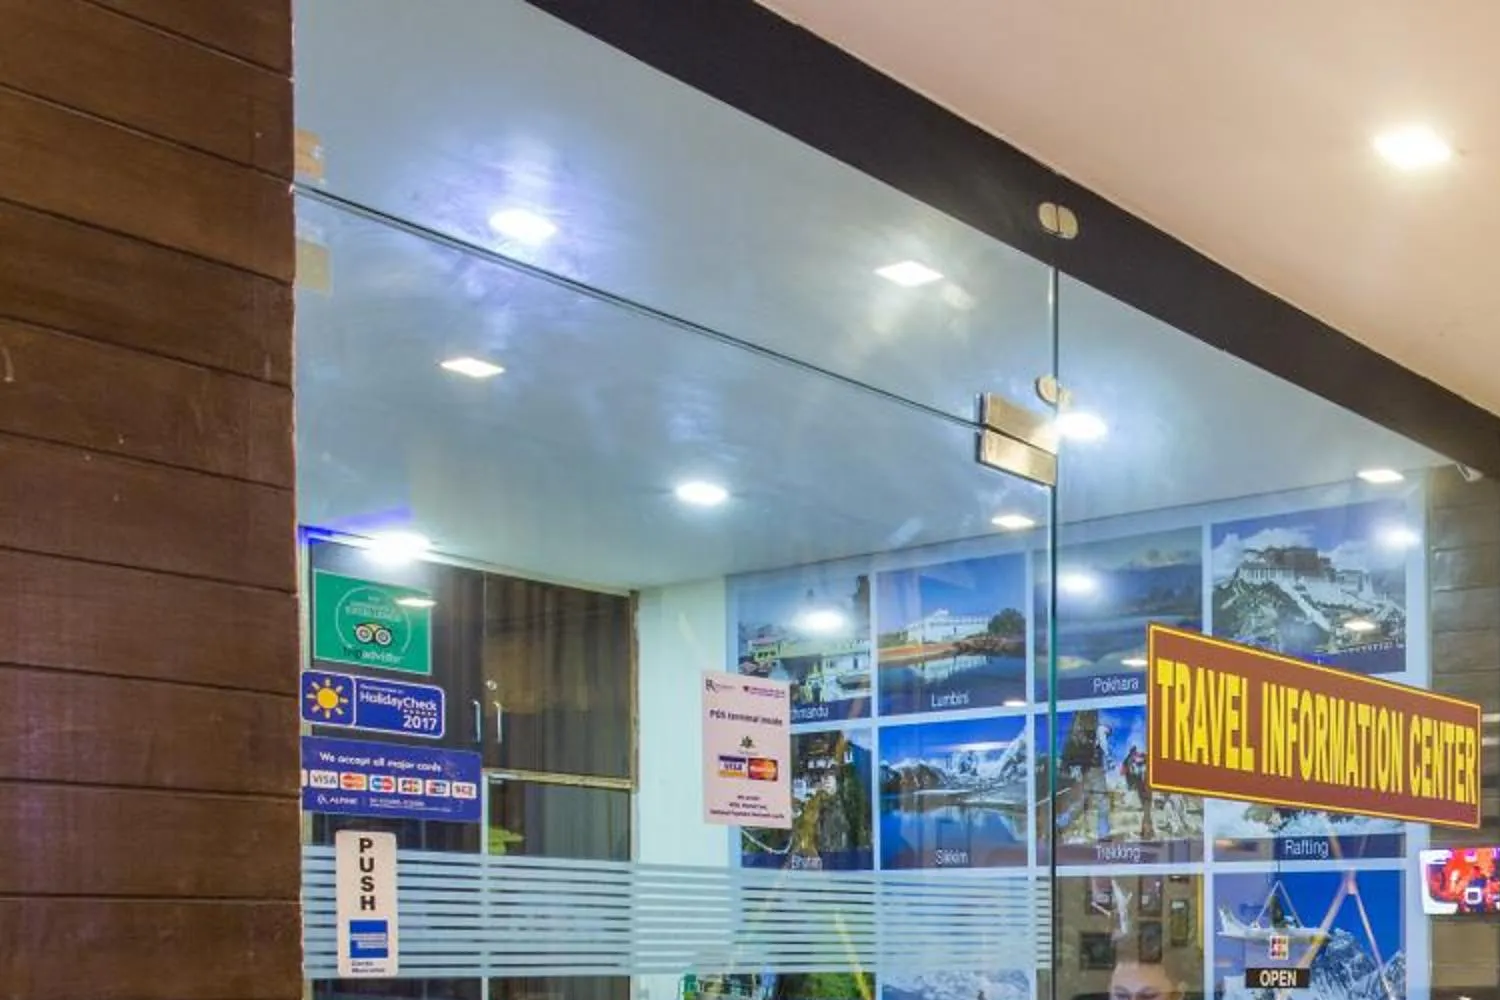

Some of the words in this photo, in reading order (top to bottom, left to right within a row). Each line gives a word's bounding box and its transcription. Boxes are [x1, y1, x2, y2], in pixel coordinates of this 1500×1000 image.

[1093, 676, 1139, 694] Pokhara
[360, 690, 436, 711] HolidayCheck
[403, 714, 437, 731] 2017
[1156, 657, 1255, 773] TRAVEL
[1262, 681, 1404, 794] INFORMATION
[1409, 713, 1478, 805] CENTER
[319, 751, 335, 763] We
[337, 755, 370, 767] accept
[313, 774, 337, 785] VISA
[1285, 839, 1329, 859] Rafting
[359, 837, 376, 911] PUSH
[1259, 969, 1297, 987] OPEN
